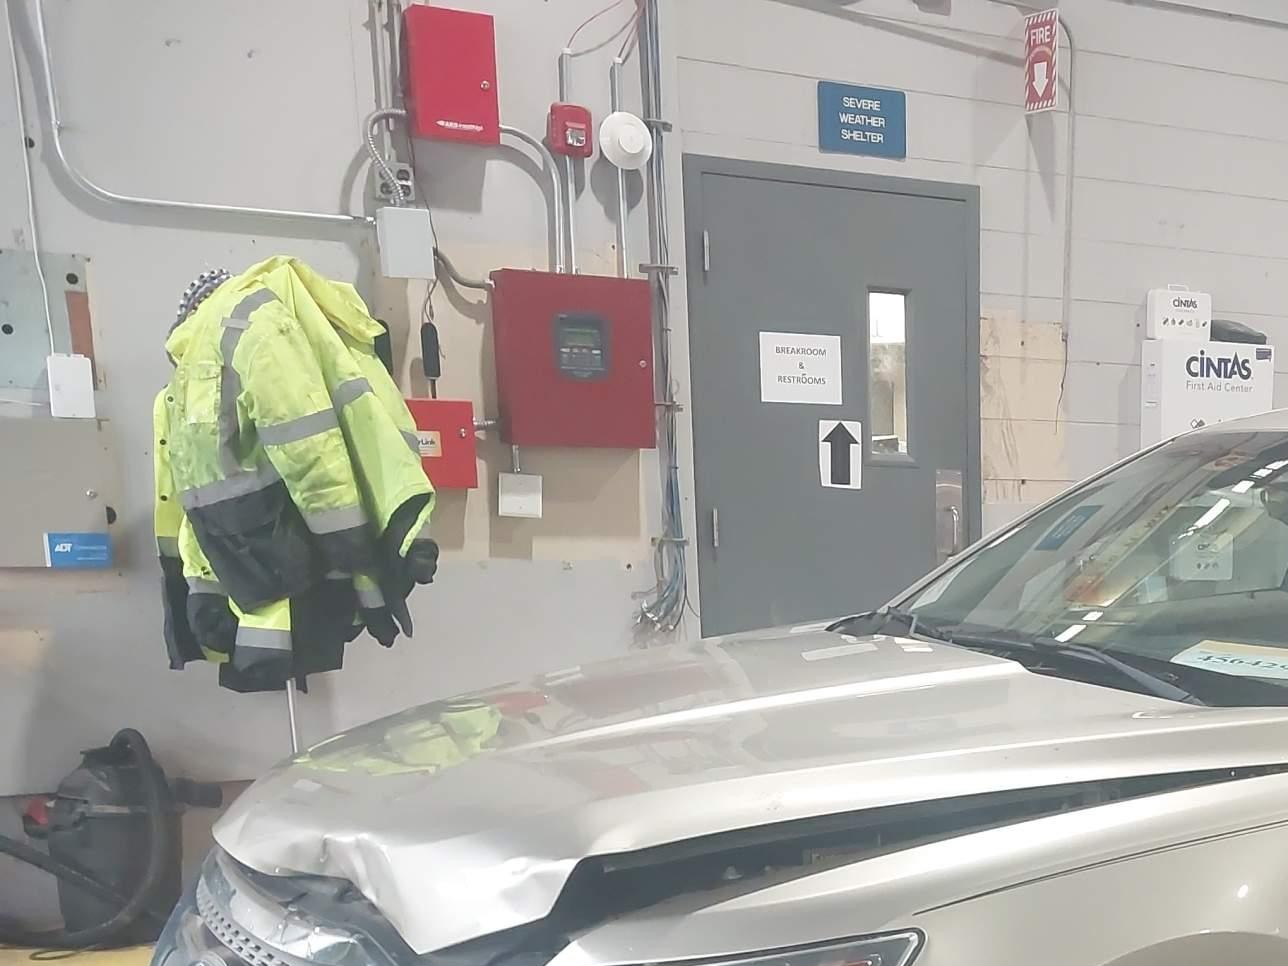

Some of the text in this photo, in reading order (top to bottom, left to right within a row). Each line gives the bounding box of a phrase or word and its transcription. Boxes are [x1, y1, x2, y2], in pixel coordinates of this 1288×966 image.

[1030, 25, 1051, 46] FIRE
[842, 96, 881, 111] SEVERE
[838, 112, 886, 128] WEATHER
[841, 129, 884, 144] SHELTER
[775, 346, 827, 357] BREAKROOM
[798, 361, 805, 369] &
[777, 375, 827, 385] RESTROOMS
[1186, 380, 1254, 393] First Aid Center
